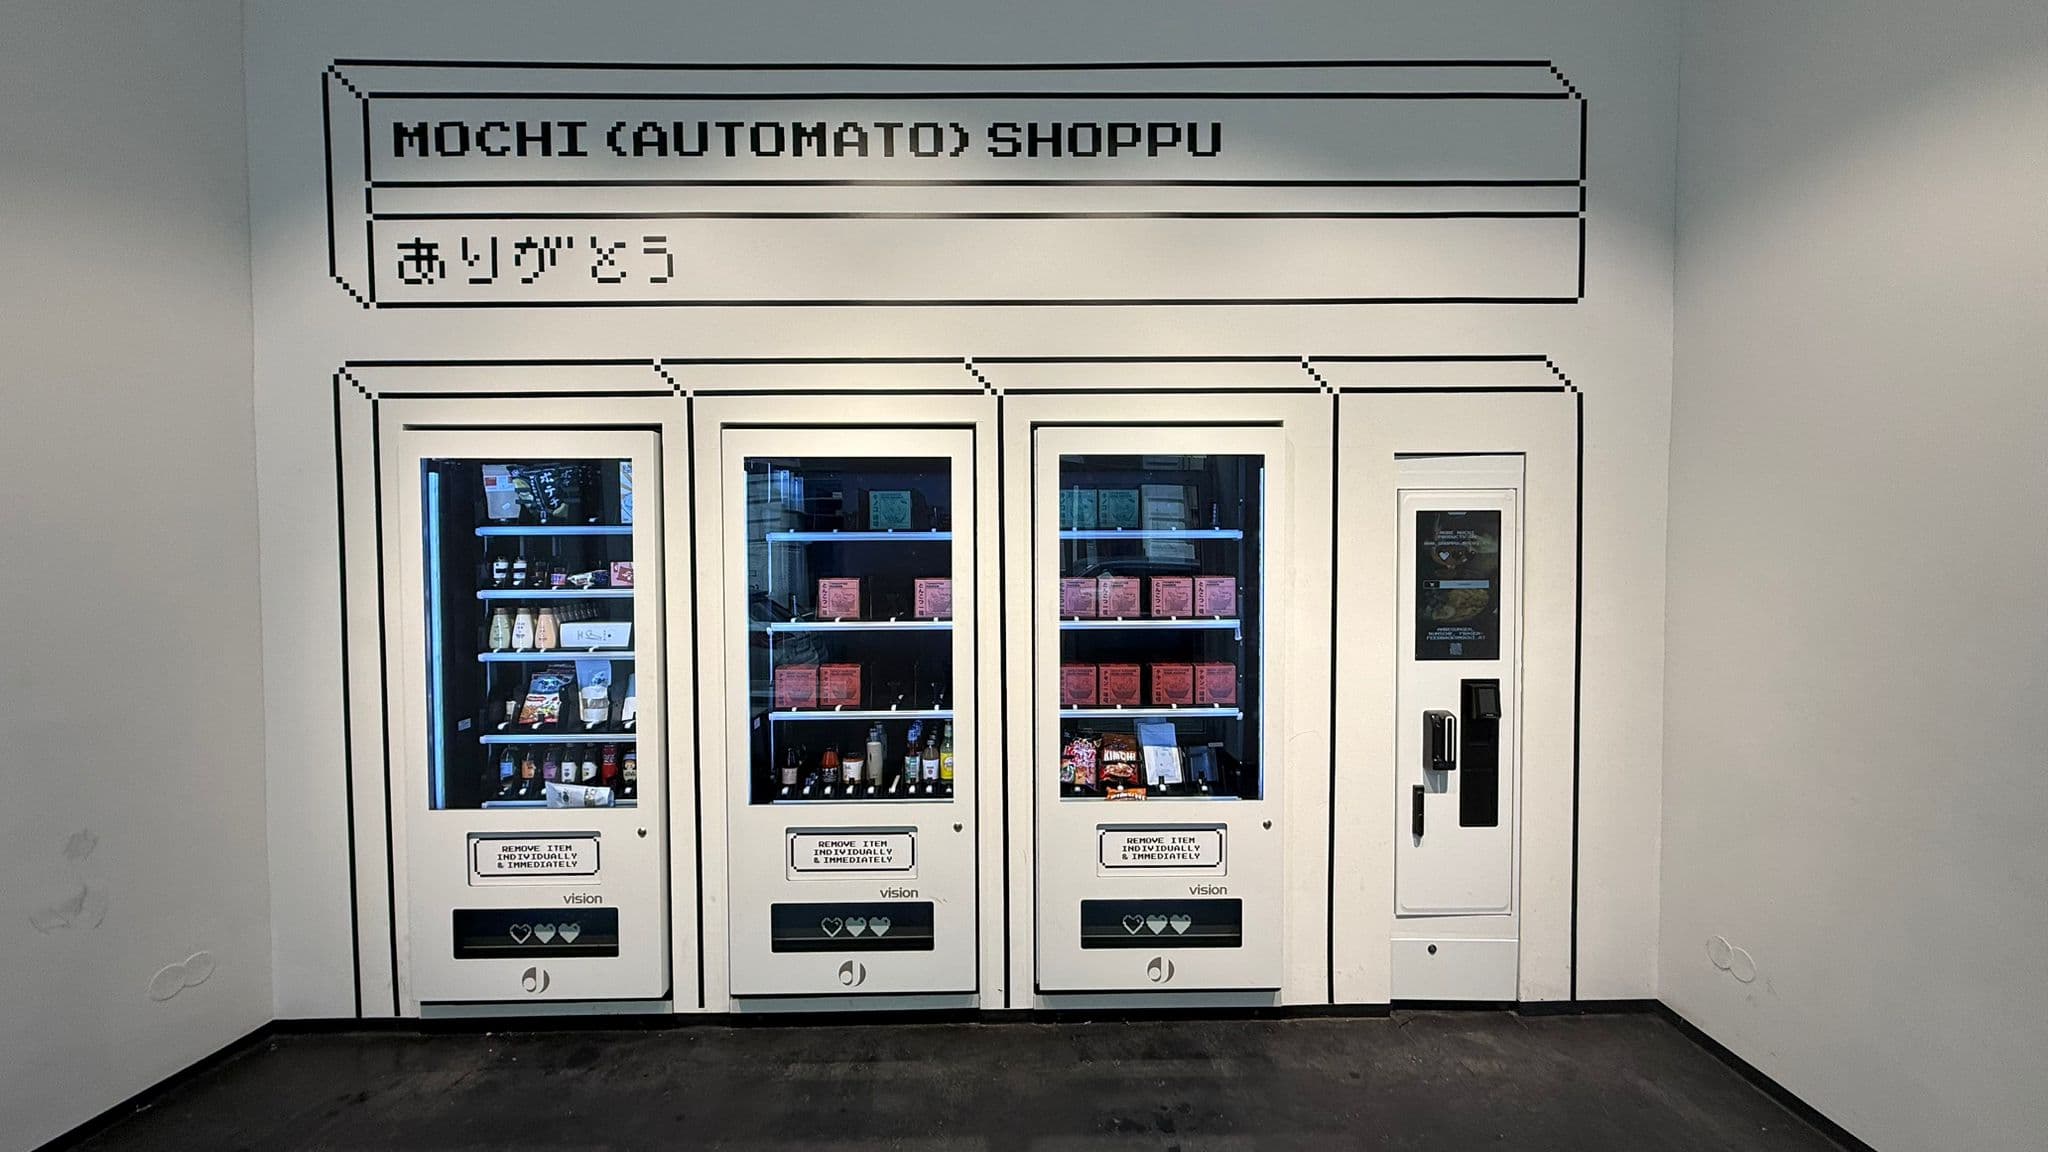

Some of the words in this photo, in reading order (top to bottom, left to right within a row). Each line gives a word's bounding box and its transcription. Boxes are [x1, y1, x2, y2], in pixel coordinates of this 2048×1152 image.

[393, 121, 588, 158] MOCHI
[605, 120, 971, 158] (AUTOMATO)
[987, 120, 1222, 158] SHOPPU
[396, 235, 675, 286] ありがとう
[818, 840, 857, 848] REMOVE
[508, 860, 578, 868] IMMEDIATELY
[880, 887, 919, 898] vision
[1189, 884, 1228, 895] vision
[563, 893, 603, 904] vision
